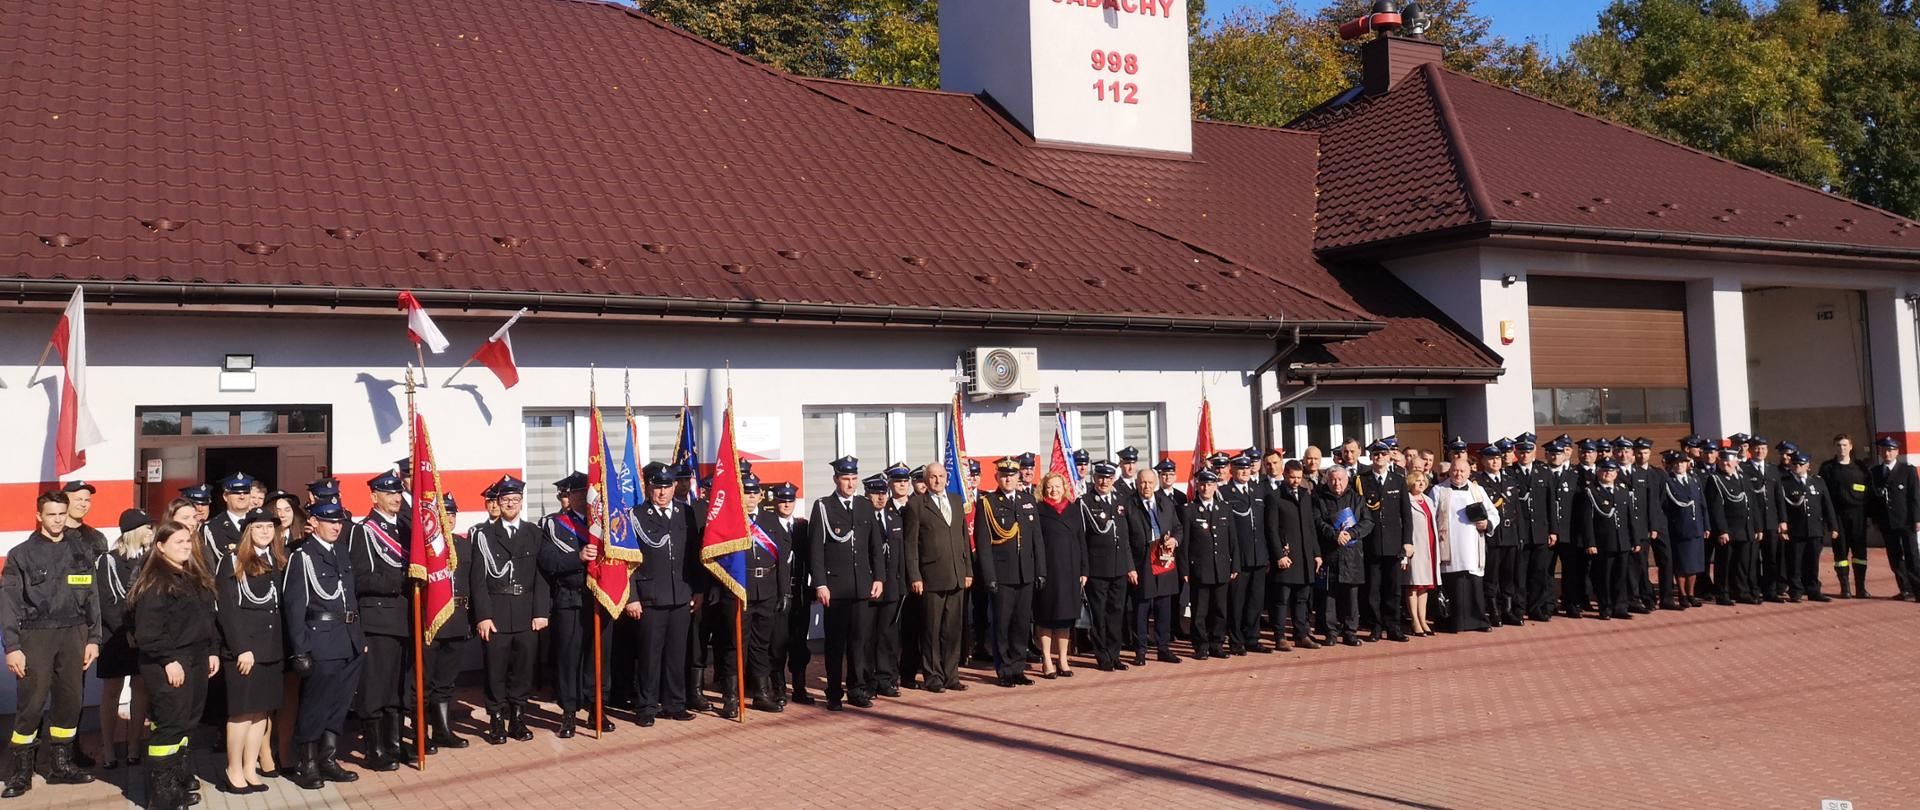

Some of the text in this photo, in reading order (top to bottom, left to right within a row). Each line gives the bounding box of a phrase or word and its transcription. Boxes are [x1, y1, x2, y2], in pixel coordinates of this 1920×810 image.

[1090, 48, 1138, 75] 998
[1092, 78, 1139, 105] 112
[706, 486, 726, 524] CHWA
